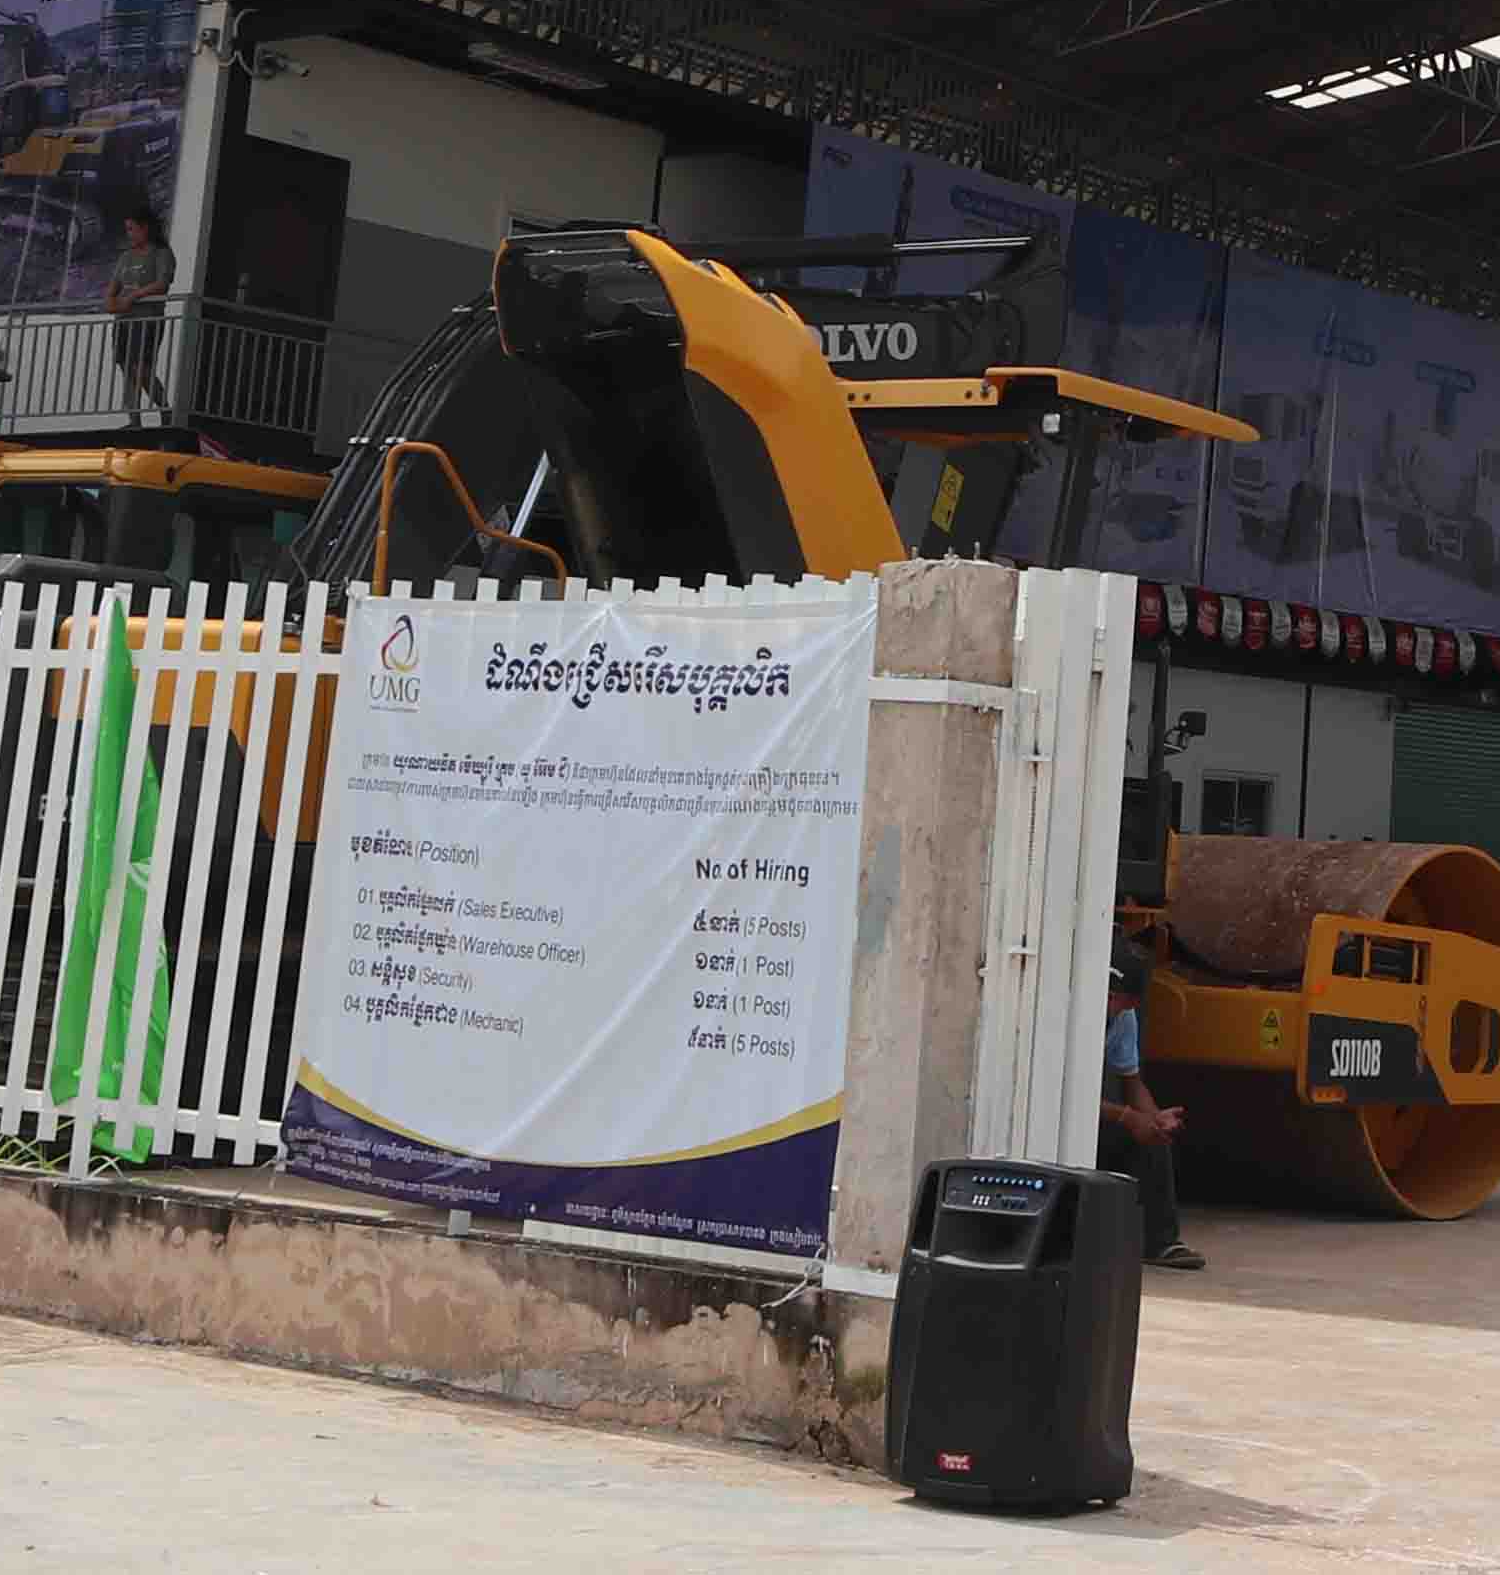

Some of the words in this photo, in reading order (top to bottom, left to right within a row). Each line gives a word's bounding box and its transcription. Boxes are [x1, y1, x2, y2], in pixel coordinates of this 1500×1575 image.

[818, 322, 918, 362] LVO
[370, 674, 420, 704] UMG
[415, 839, 480, 868] (Position)
[727, 858, 747, 879] of
[756, 858, 809, 887] Hiring
[458, 897, 498, 919] (Sales
[500, 902, 564, 926] Executive)
[459, 935, 534, 960] (Warehouse
[537, 942, 586, 967] Officer)
[419, 966, 473, 993] (Security)
[756, 955, 794, 981] Post)
[754, 995, 791, 1021] Post)
[460, 1009, 524, 1038] (Mechanic)
[748, 1034, 796, 1062] Posts)
[1329, 1038, 1382, 1079] SD110B
